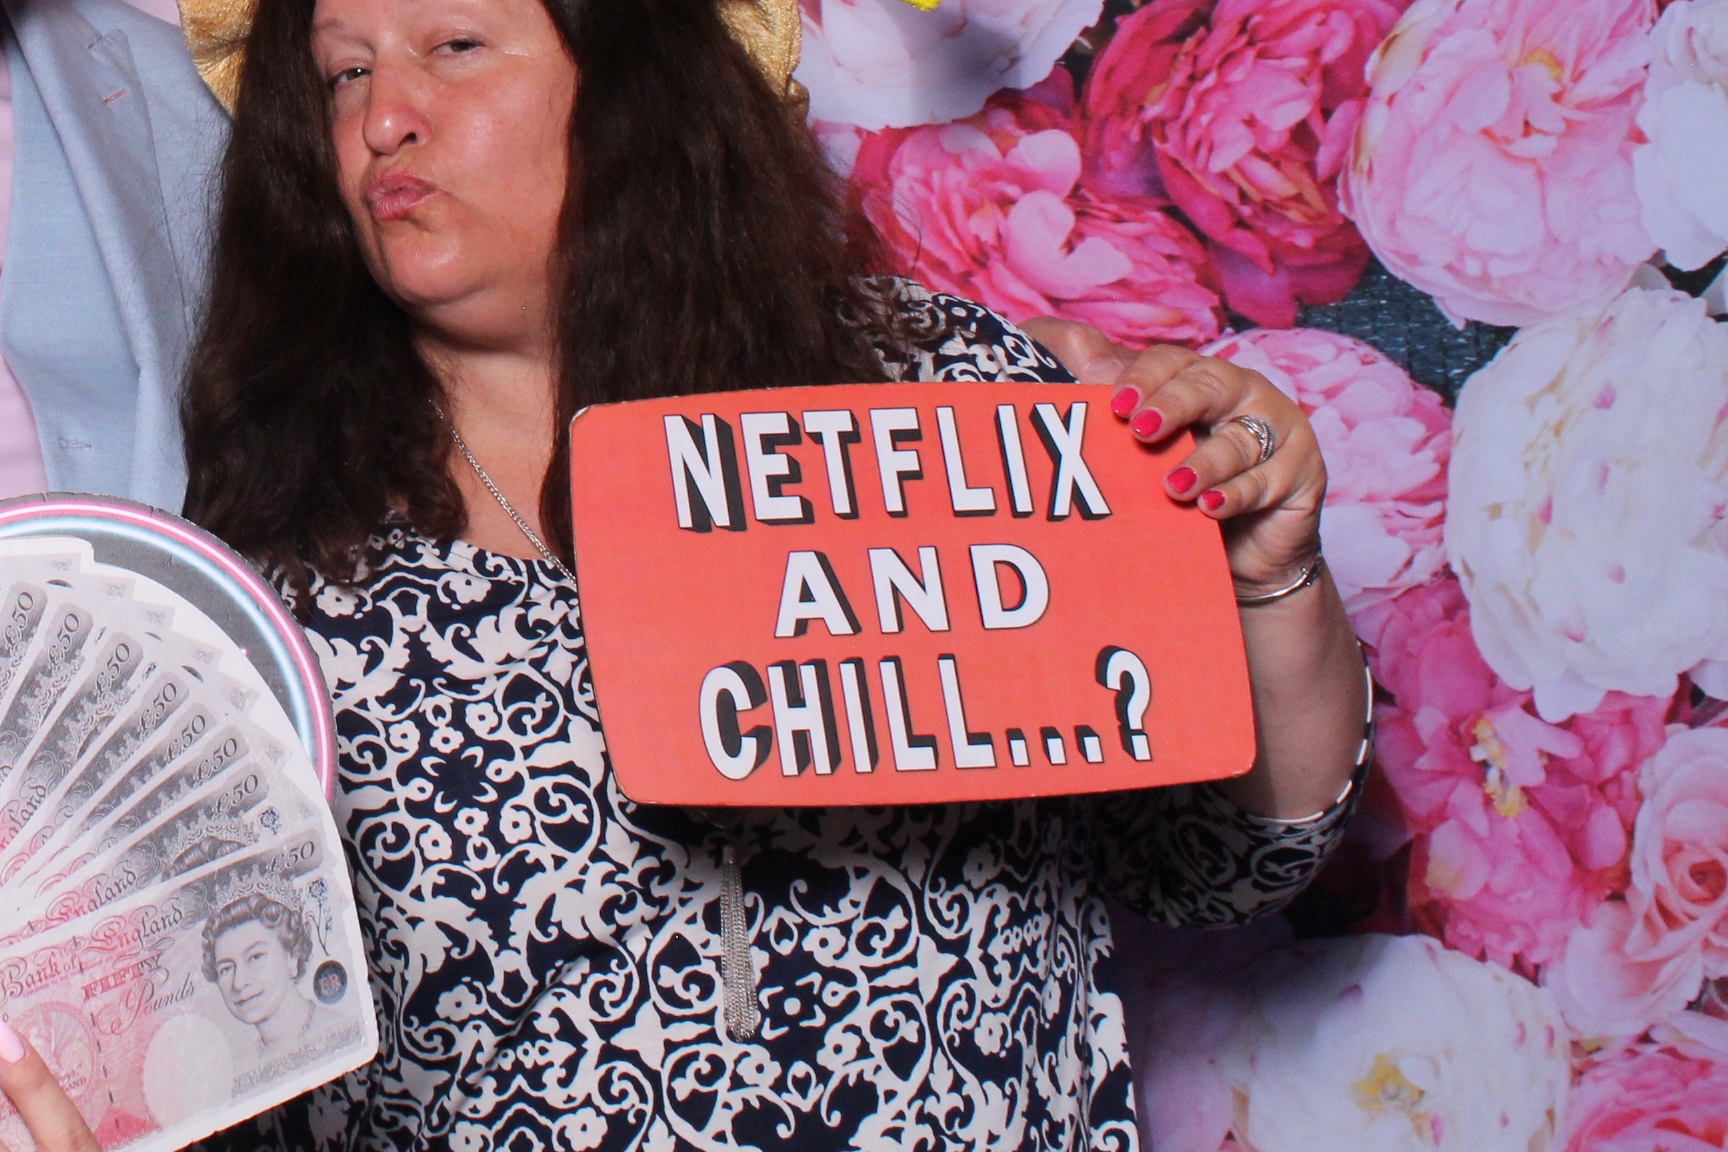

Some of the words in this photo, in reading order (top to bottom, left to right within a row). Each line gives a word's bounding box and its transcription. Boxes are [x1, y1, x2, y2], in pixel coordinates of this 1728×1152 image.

[663, 402, 1112, 532] NETFLIX
[774, 543, 1050, 638] AND
[4, 591, 34, 649] £50
[48, 612, 80, 667] £50
[93, 642, 130, 697] £50
[137, 682, 177, 734] £50
[698, 646, 1152, 780] CHILL...?
[164, 714, 206, 763] £50
[194, 738, 238, 783] £50
[213, 774, 259, 814] £50
[266, 840, 315, 873] £50
[90, 898, 184, 952] England
[81, 953, 164, 1001] FIFTY
[96, 973, 195, 1035] Pounds
